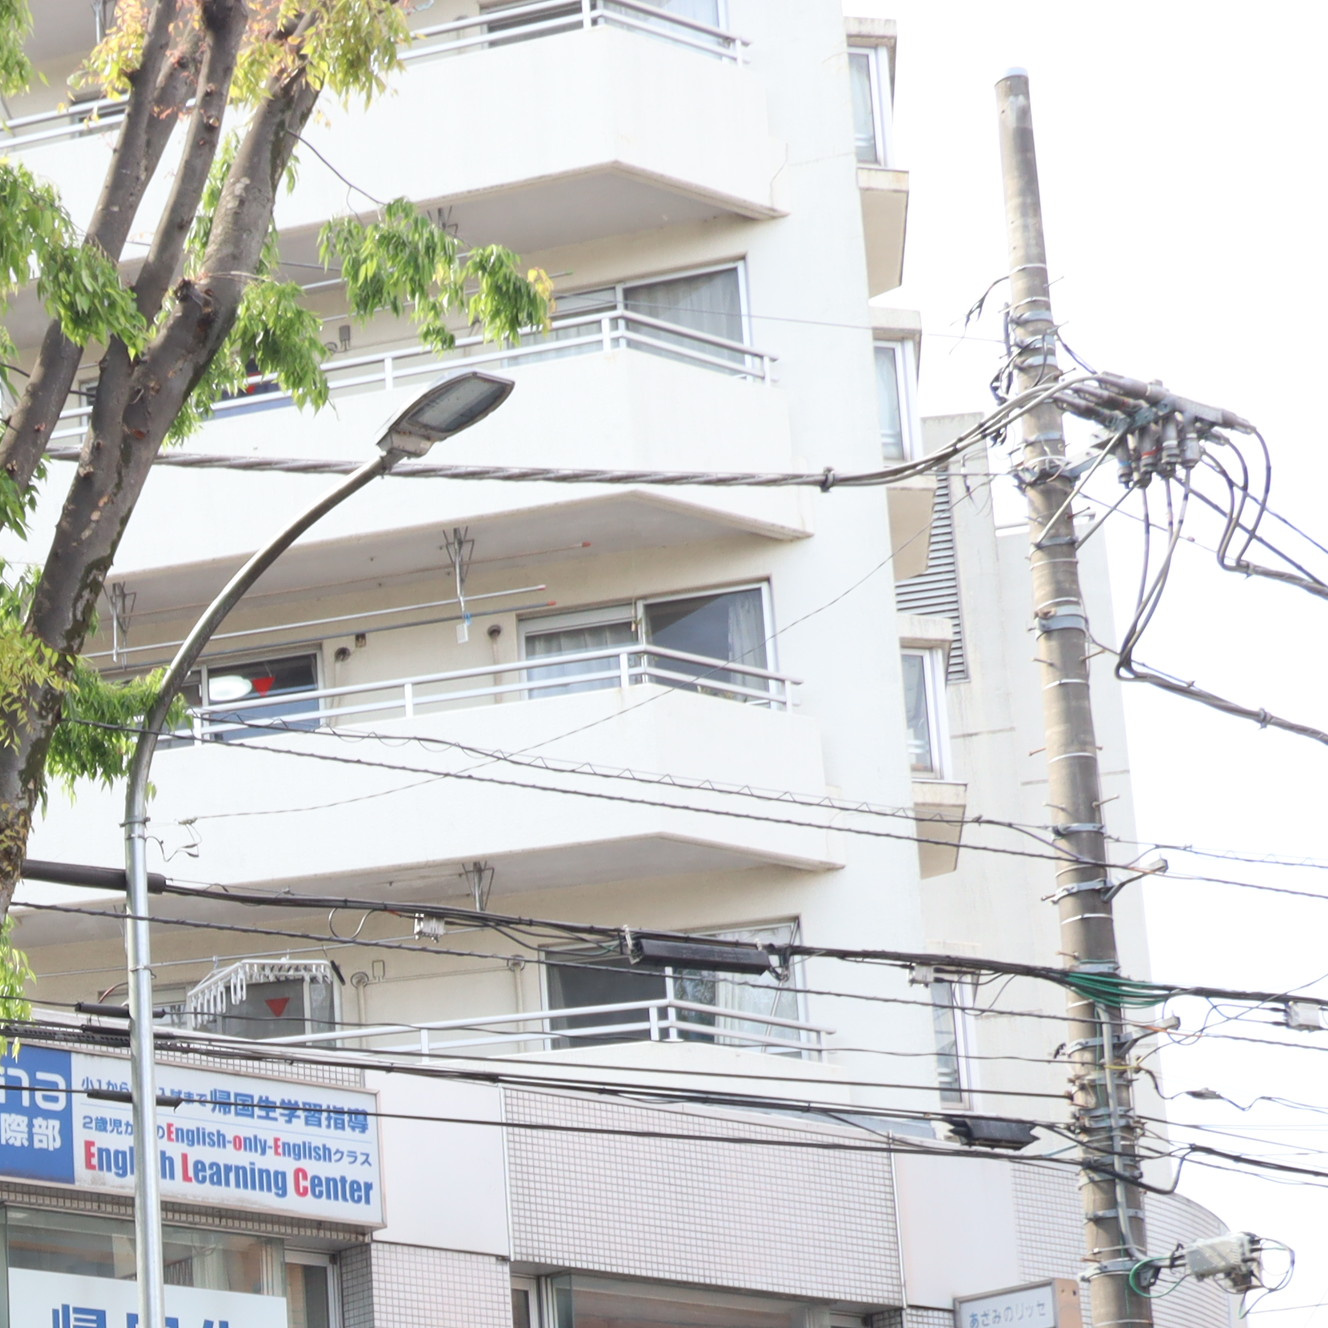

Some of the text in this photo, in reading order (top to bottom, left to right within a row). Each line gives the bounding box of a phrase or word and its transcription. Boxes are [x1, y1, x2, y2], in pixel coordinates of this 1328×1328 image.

[84, 1140, 373, 1205] Englh Learning Center
